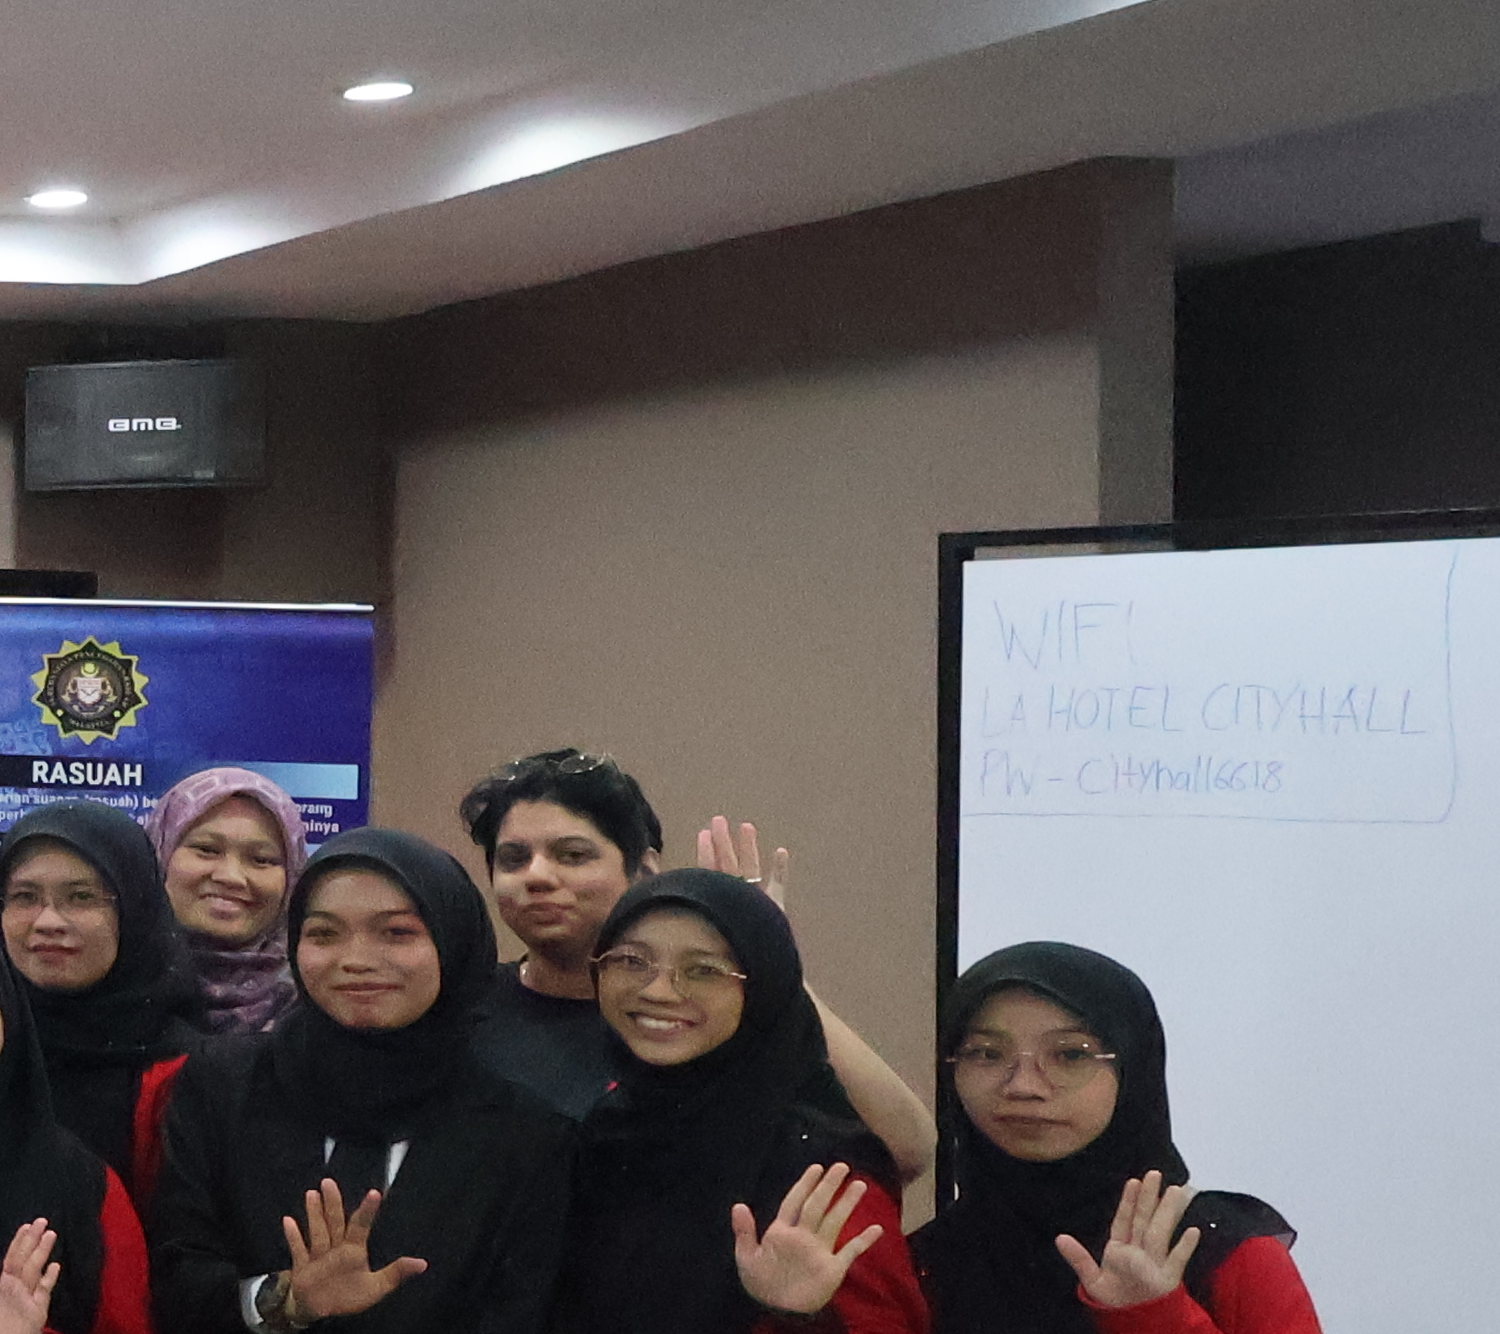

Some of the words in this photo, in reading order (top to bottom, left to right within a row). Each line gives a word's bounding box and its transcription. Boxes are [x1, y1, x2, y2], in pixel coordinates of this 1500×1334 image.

[980, 685, 1027, 738] LA
[1048, 683, 1186, 732] HOTEL
[32, 760, 143, 786] RASUAH
